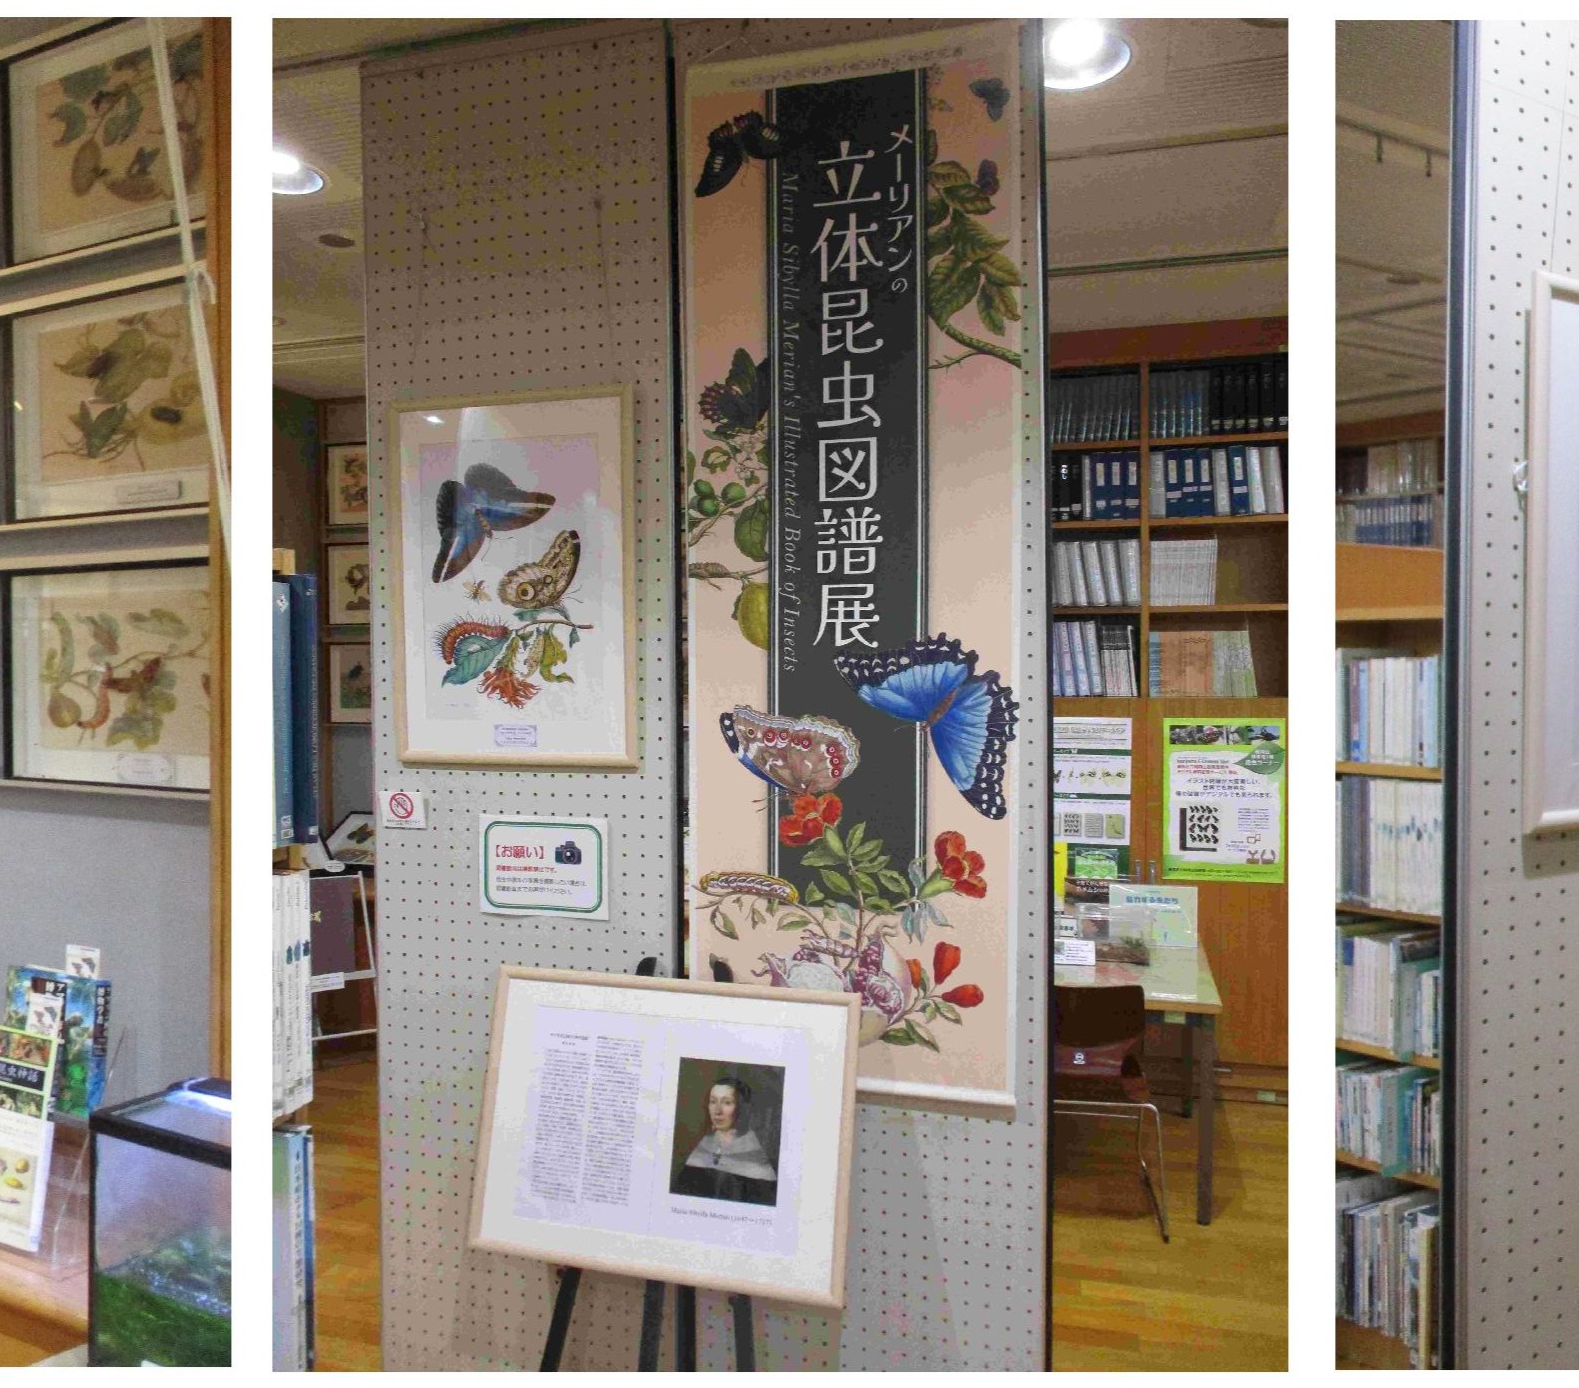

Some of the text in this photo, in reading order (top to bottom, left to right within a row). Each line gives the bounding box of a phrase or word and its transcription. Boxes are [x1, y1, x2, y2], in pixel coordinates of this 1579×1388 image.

[883, 122, 914, 295] メーリアンの
[778, 172, 802, 673] Maria Sibylla Merian's Illustrated Book of Insects
[810, 139, 885, 649] 立体昆虫図譜展
[495, 844, 545, 860] 【お願い】
